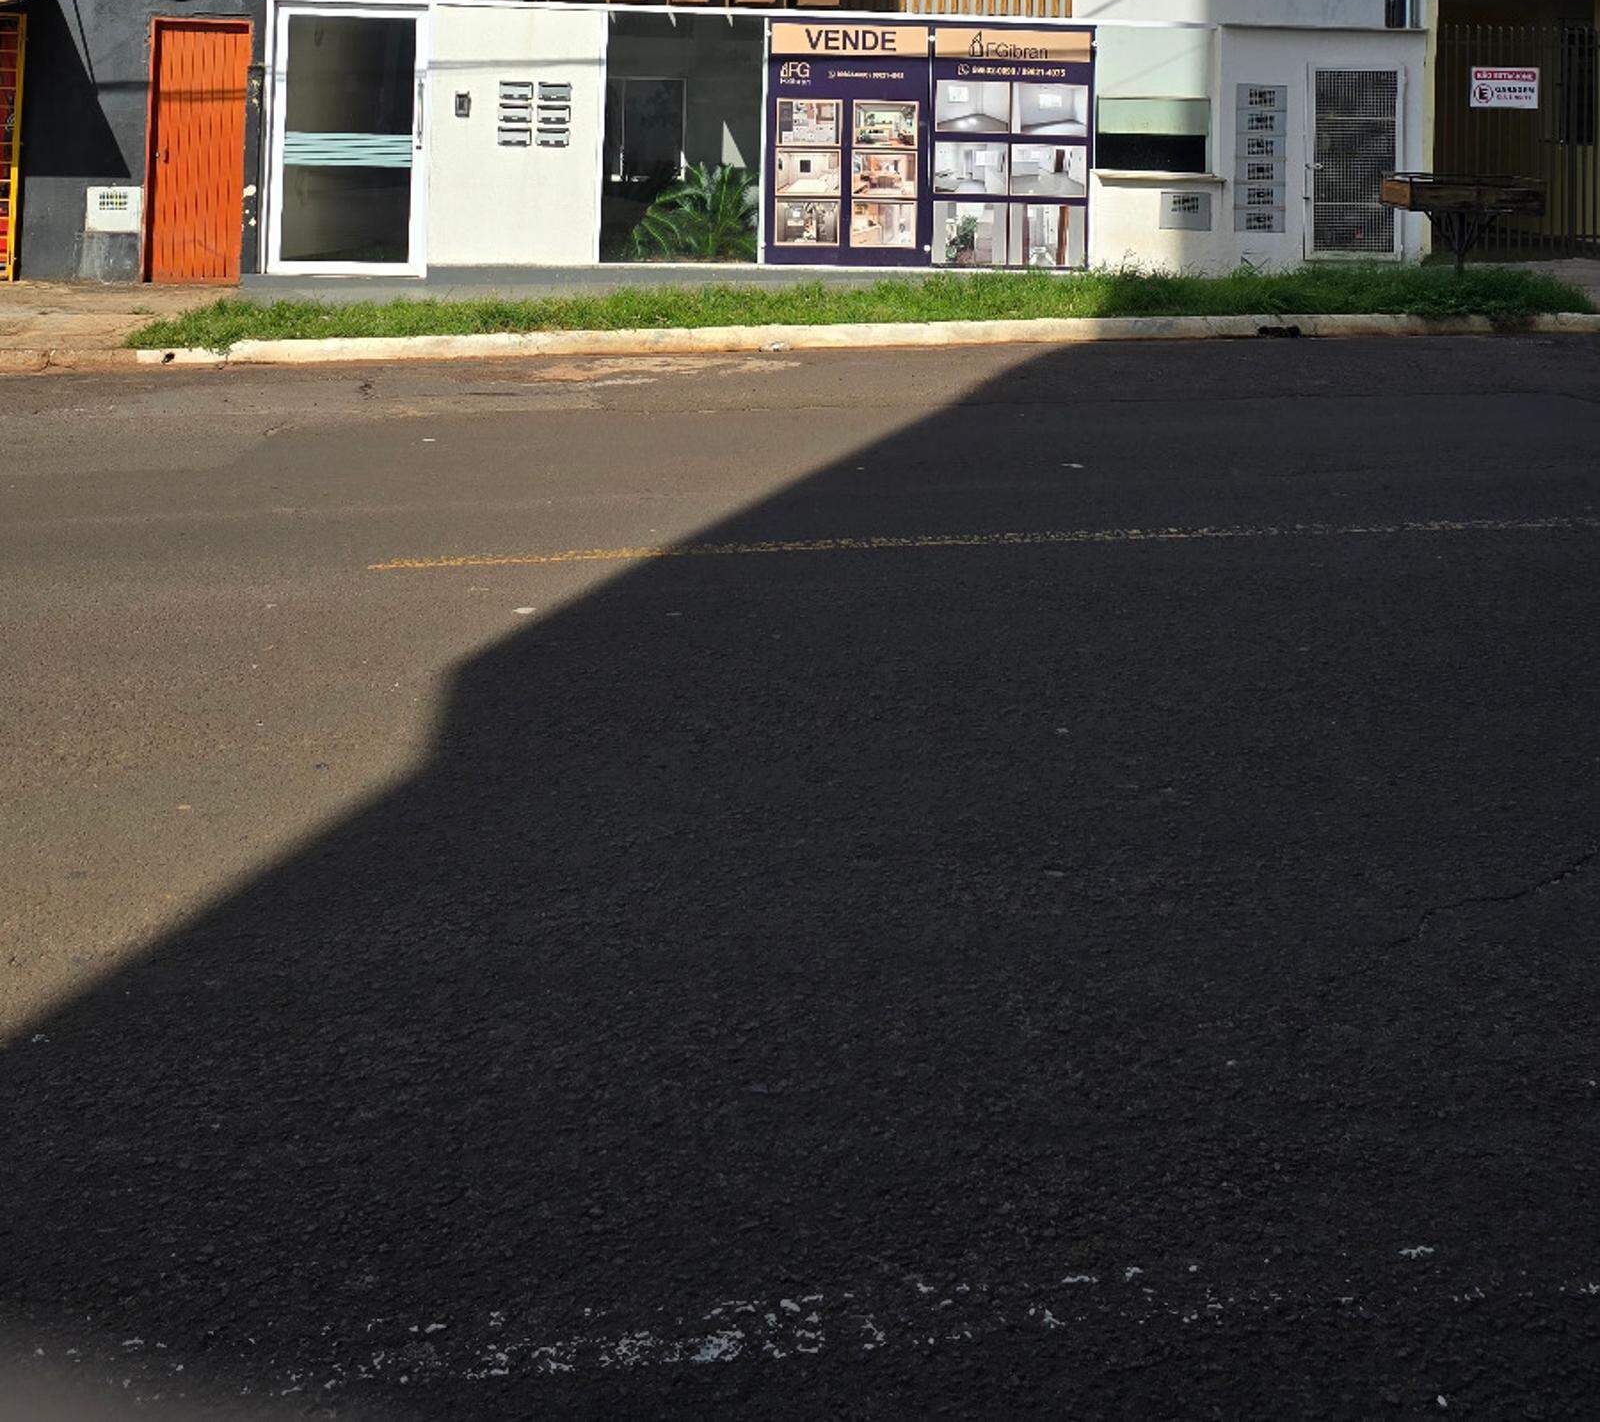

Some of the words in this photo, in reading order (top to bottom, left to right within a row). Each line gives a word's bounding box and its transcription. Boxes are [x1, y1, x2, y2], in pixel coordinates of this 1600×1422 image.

[805, 28, 897, 52] VENDE
[986, 42, 1048, 59] FGibran
[788, 62, 811, 78] FG
